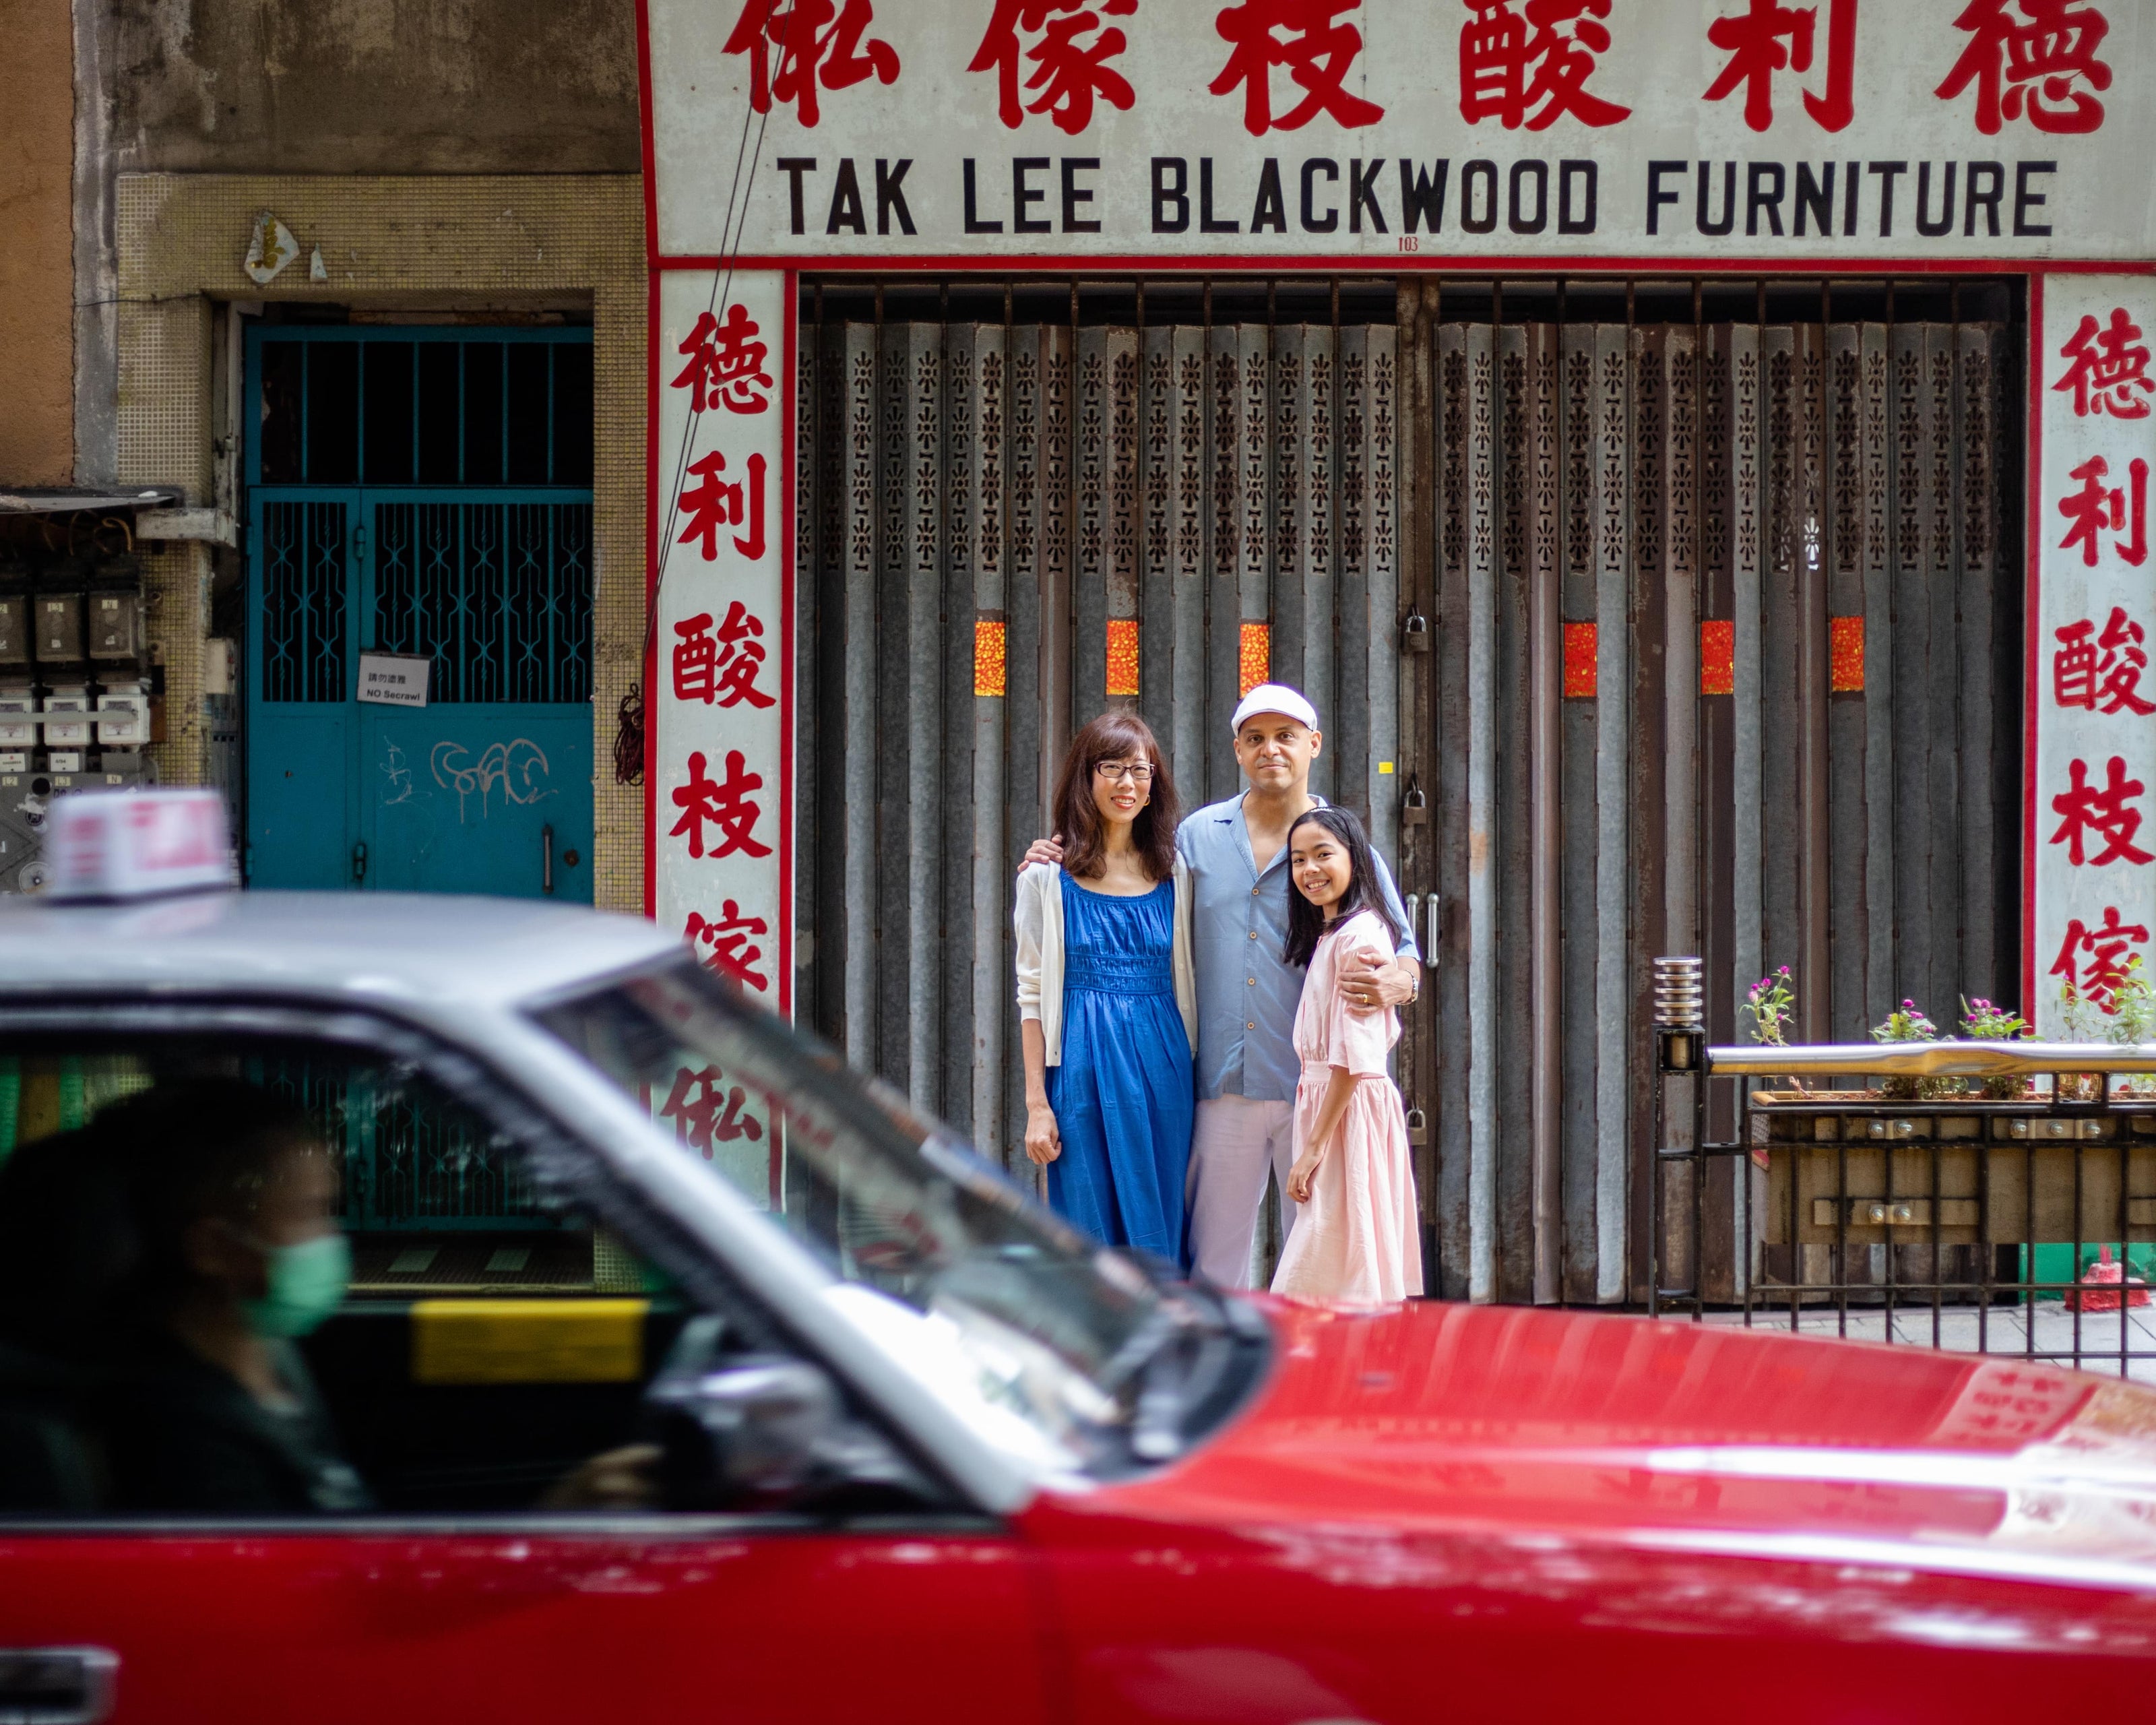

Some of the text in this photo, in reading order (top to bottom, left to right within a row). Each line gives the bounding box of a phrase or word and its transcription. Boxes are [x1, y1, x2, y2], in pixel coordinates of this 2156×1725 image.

[777, 156, 2057, 237] TAK LEE BLACKWOOD FURNITURE
[1398, 237, 1418, 252] 103
[367, 689, 420, 701] NO Secrawl
